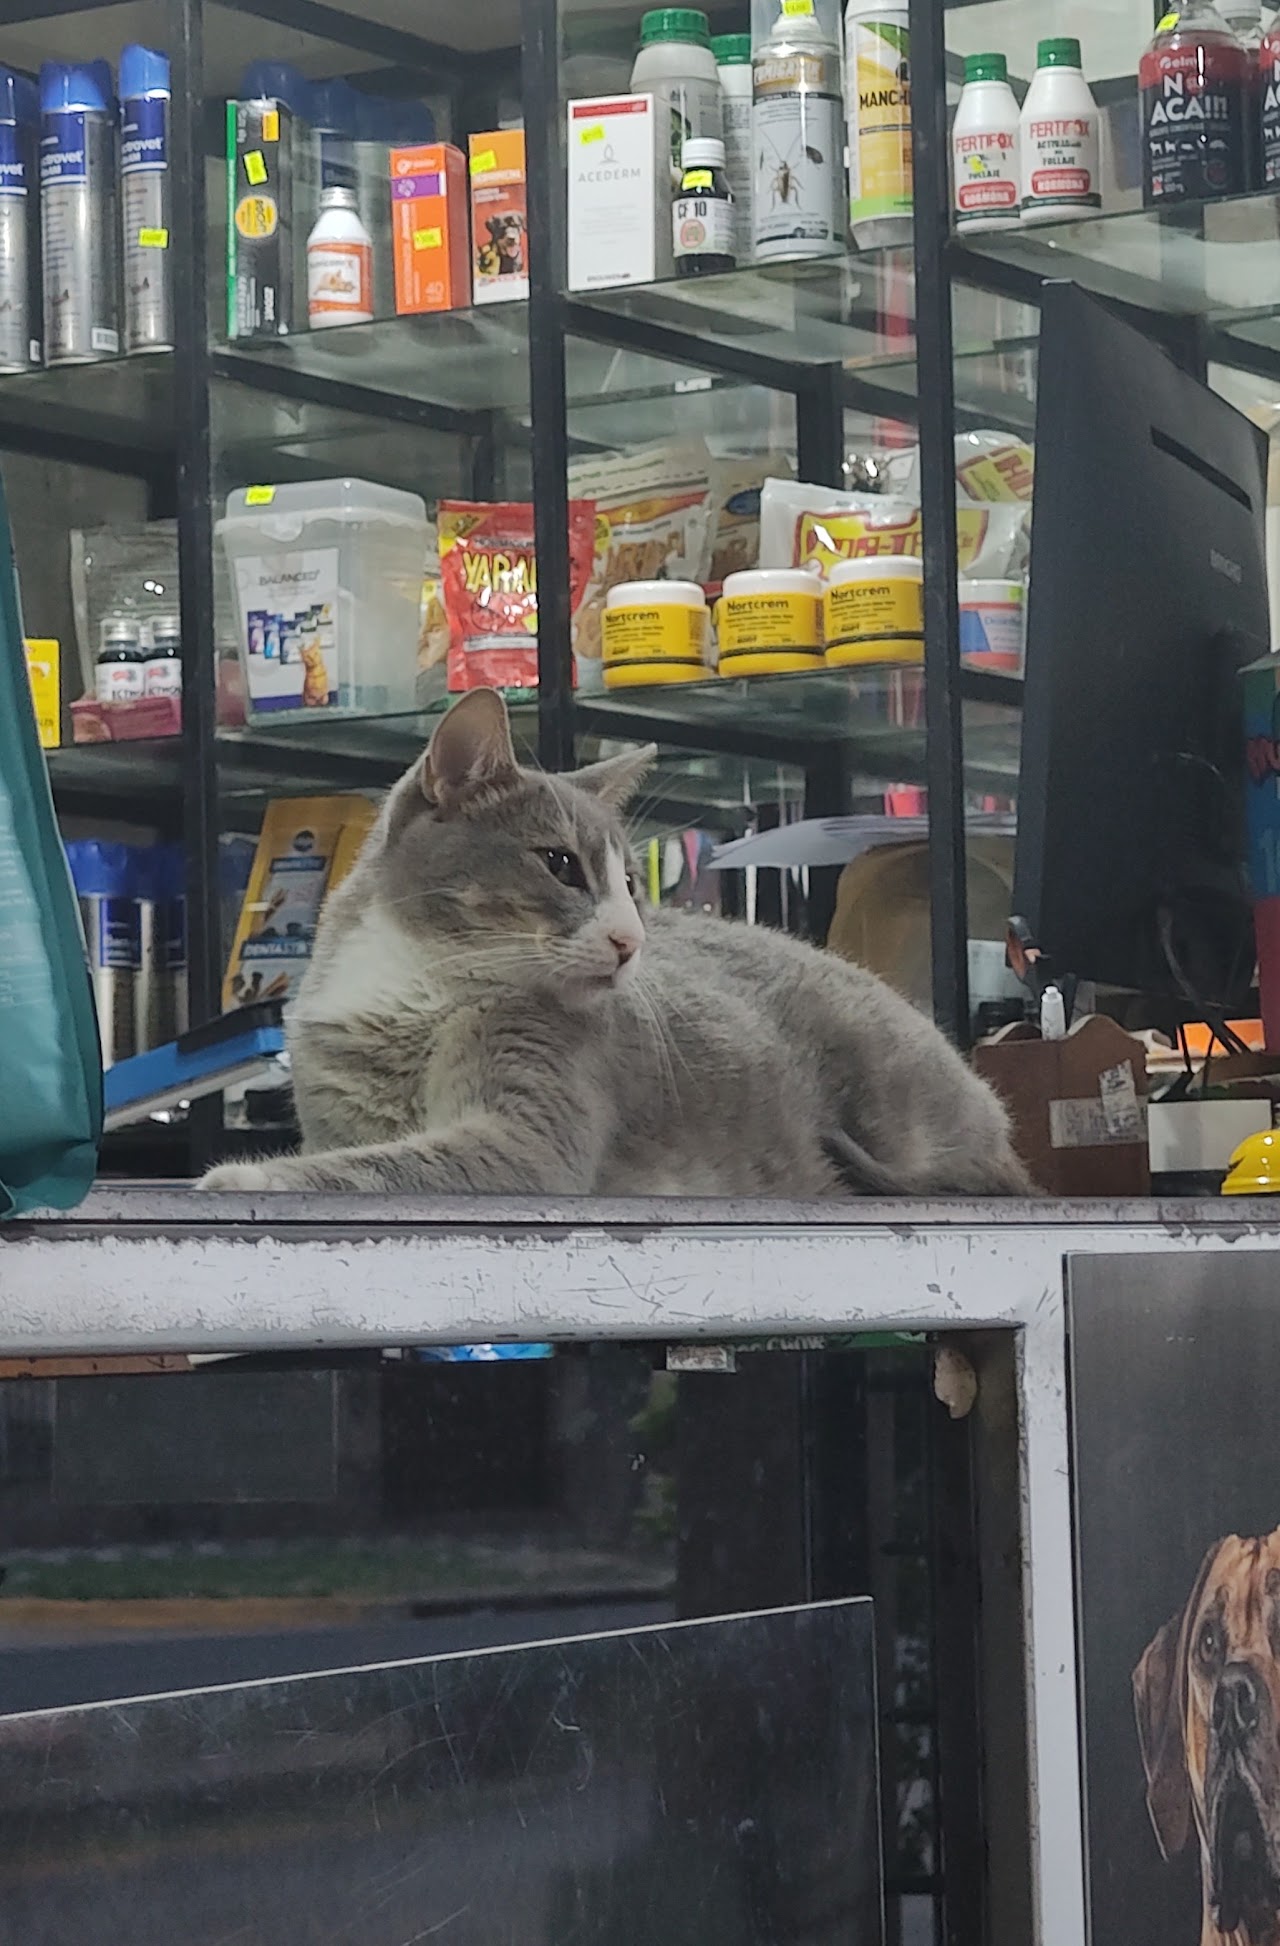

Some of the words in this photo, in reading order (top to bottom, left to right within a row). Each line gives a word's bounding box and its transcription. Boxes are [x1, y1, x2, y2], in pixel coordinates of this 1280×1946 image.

[955, 132, 1014, 153] FERTIFOX
[578, 167, 641, 183] ACEDERM
[694, 200, 707, 218] 10
[831, 586, 890, 601] Nortcrem
[727, 600, 789, 612] Nortcrem
[605, 611, 659, 623] Nortcrem
